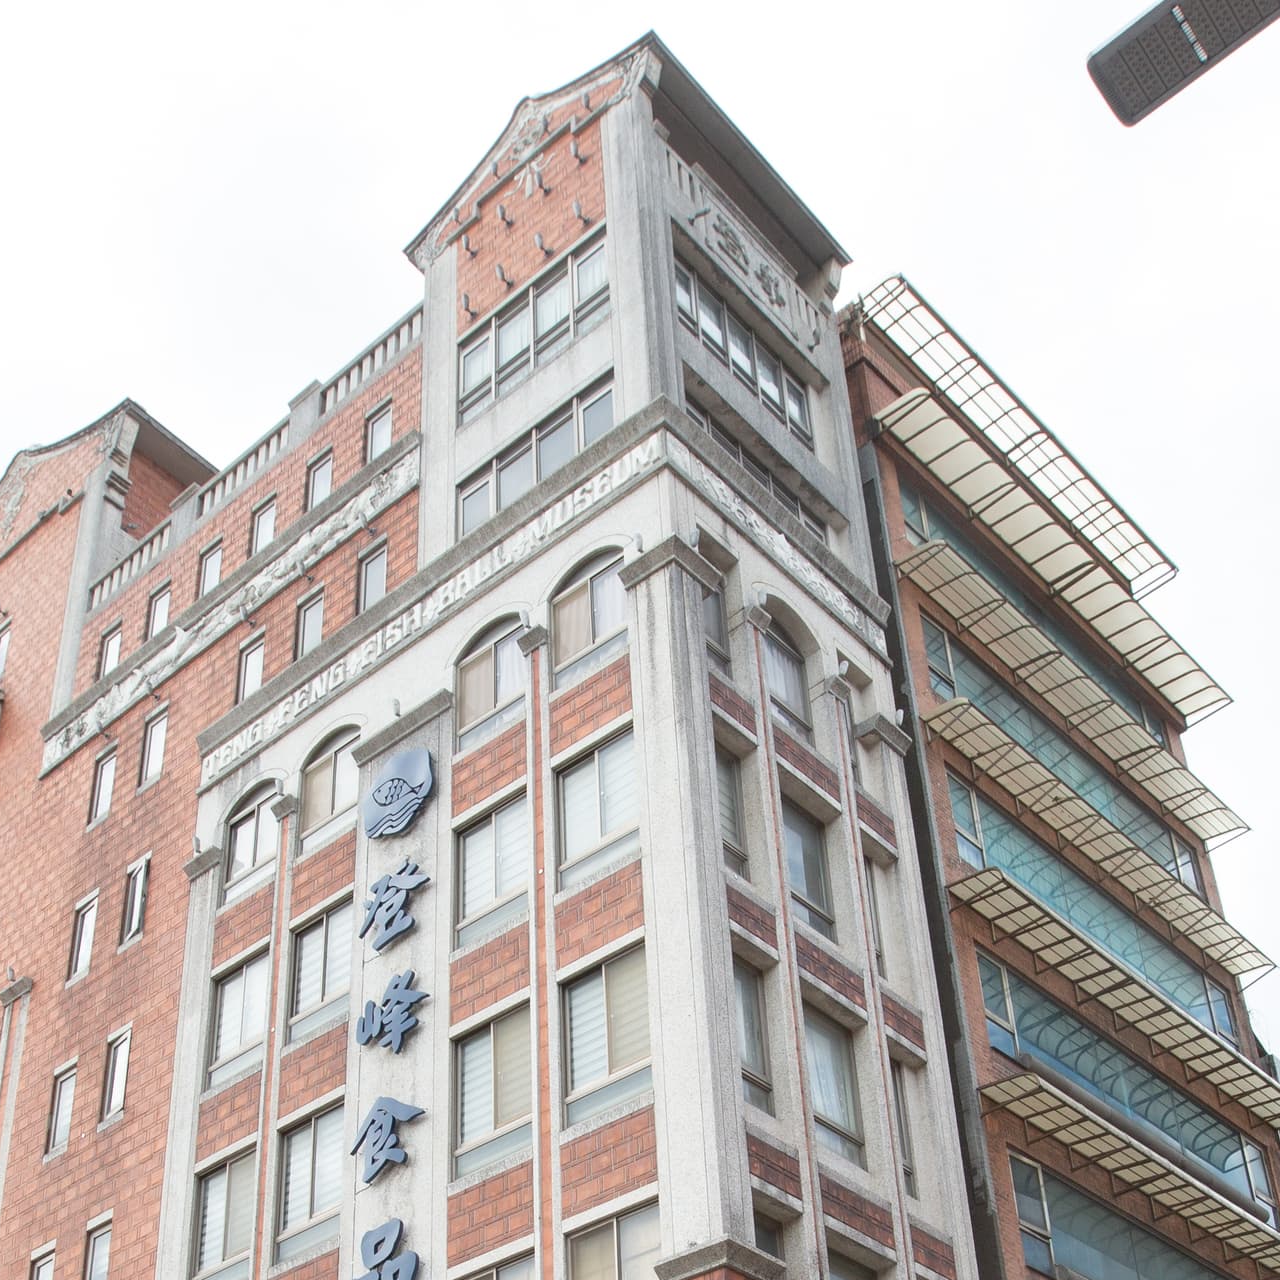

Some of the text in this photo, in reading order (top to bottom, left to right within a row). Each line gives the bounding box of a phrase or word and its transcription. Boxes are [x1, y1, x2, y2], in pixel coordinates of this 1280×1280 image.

[204, 440, 663, 778] TENG FENG FISH BALL MUSEUM
